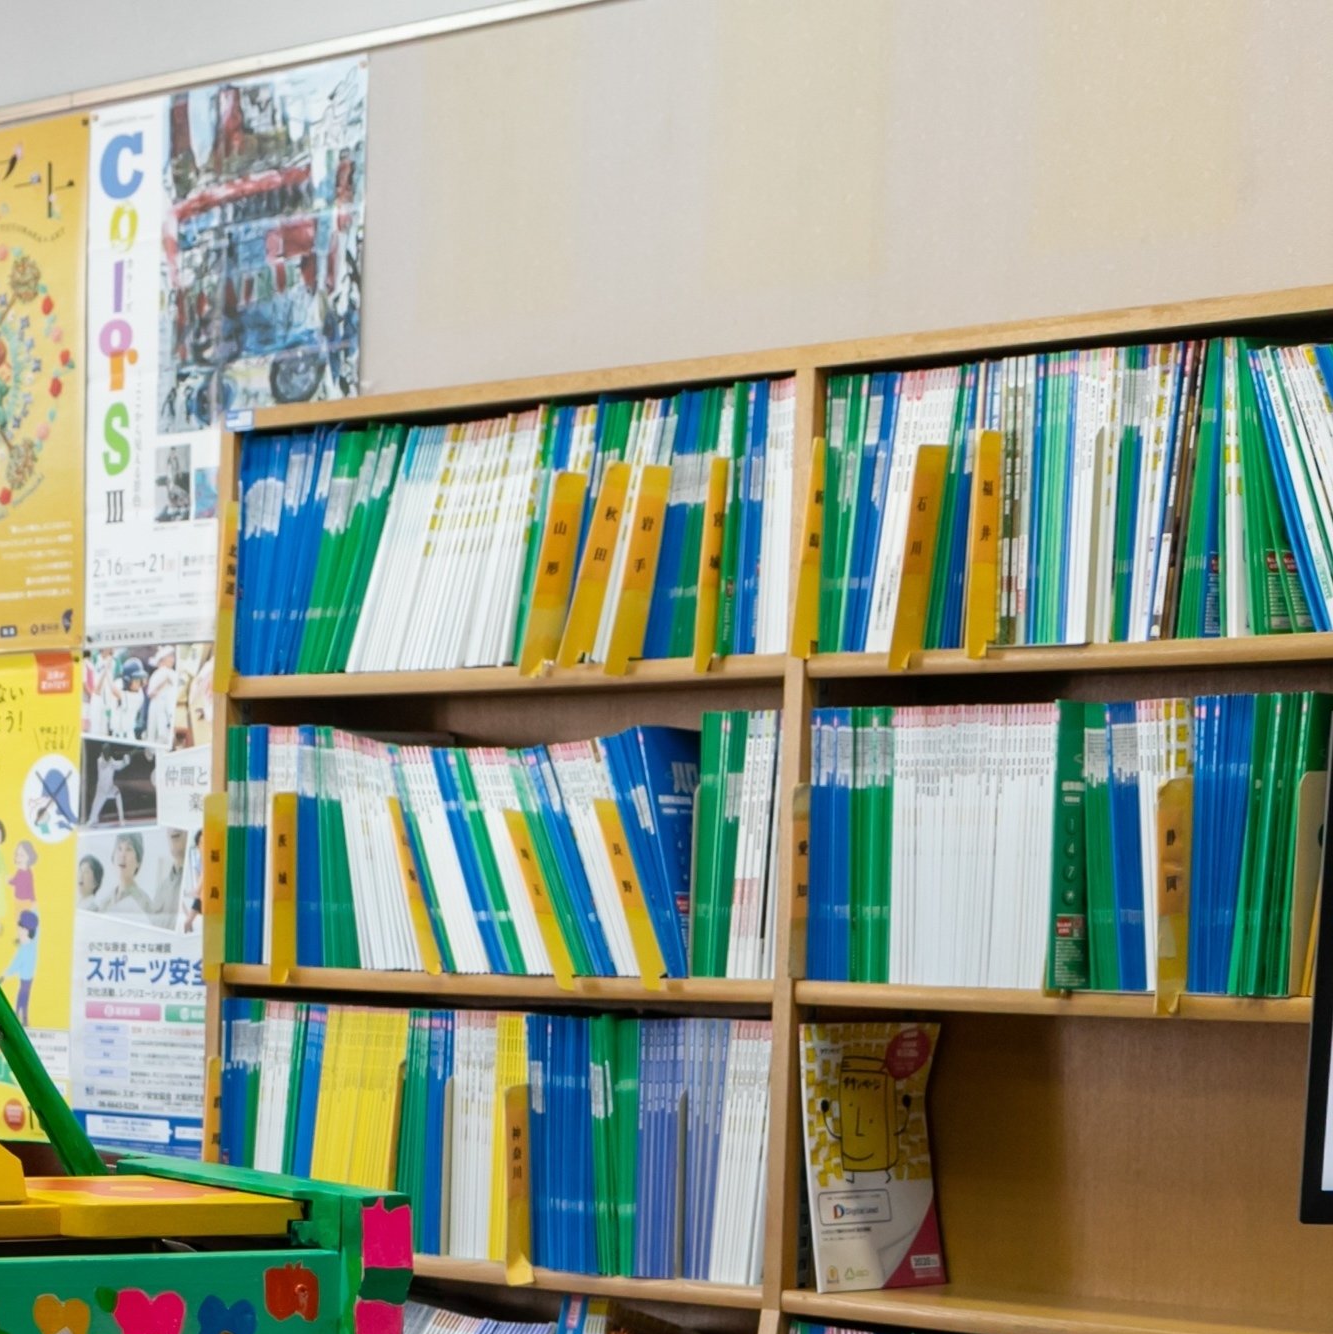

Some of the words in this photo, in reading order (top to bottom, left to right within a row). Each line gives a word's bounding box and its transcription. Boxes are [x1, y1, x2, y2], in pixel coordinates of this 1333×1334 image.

[594, 506, 619, 562] 秋田
[911, 496, 928, 556] 石川
[979, 480, 995, 542] 福井
[546, 520, 568, 575] 山形
[634, 516, 655, 573] 岩手
[165, 765, 208, 787] 仲間と
[612, 842, 633, 893] 長野
[1166, 829, 1182, 893] 静岡
[511, 1126, 523, 1180] 神奈川
